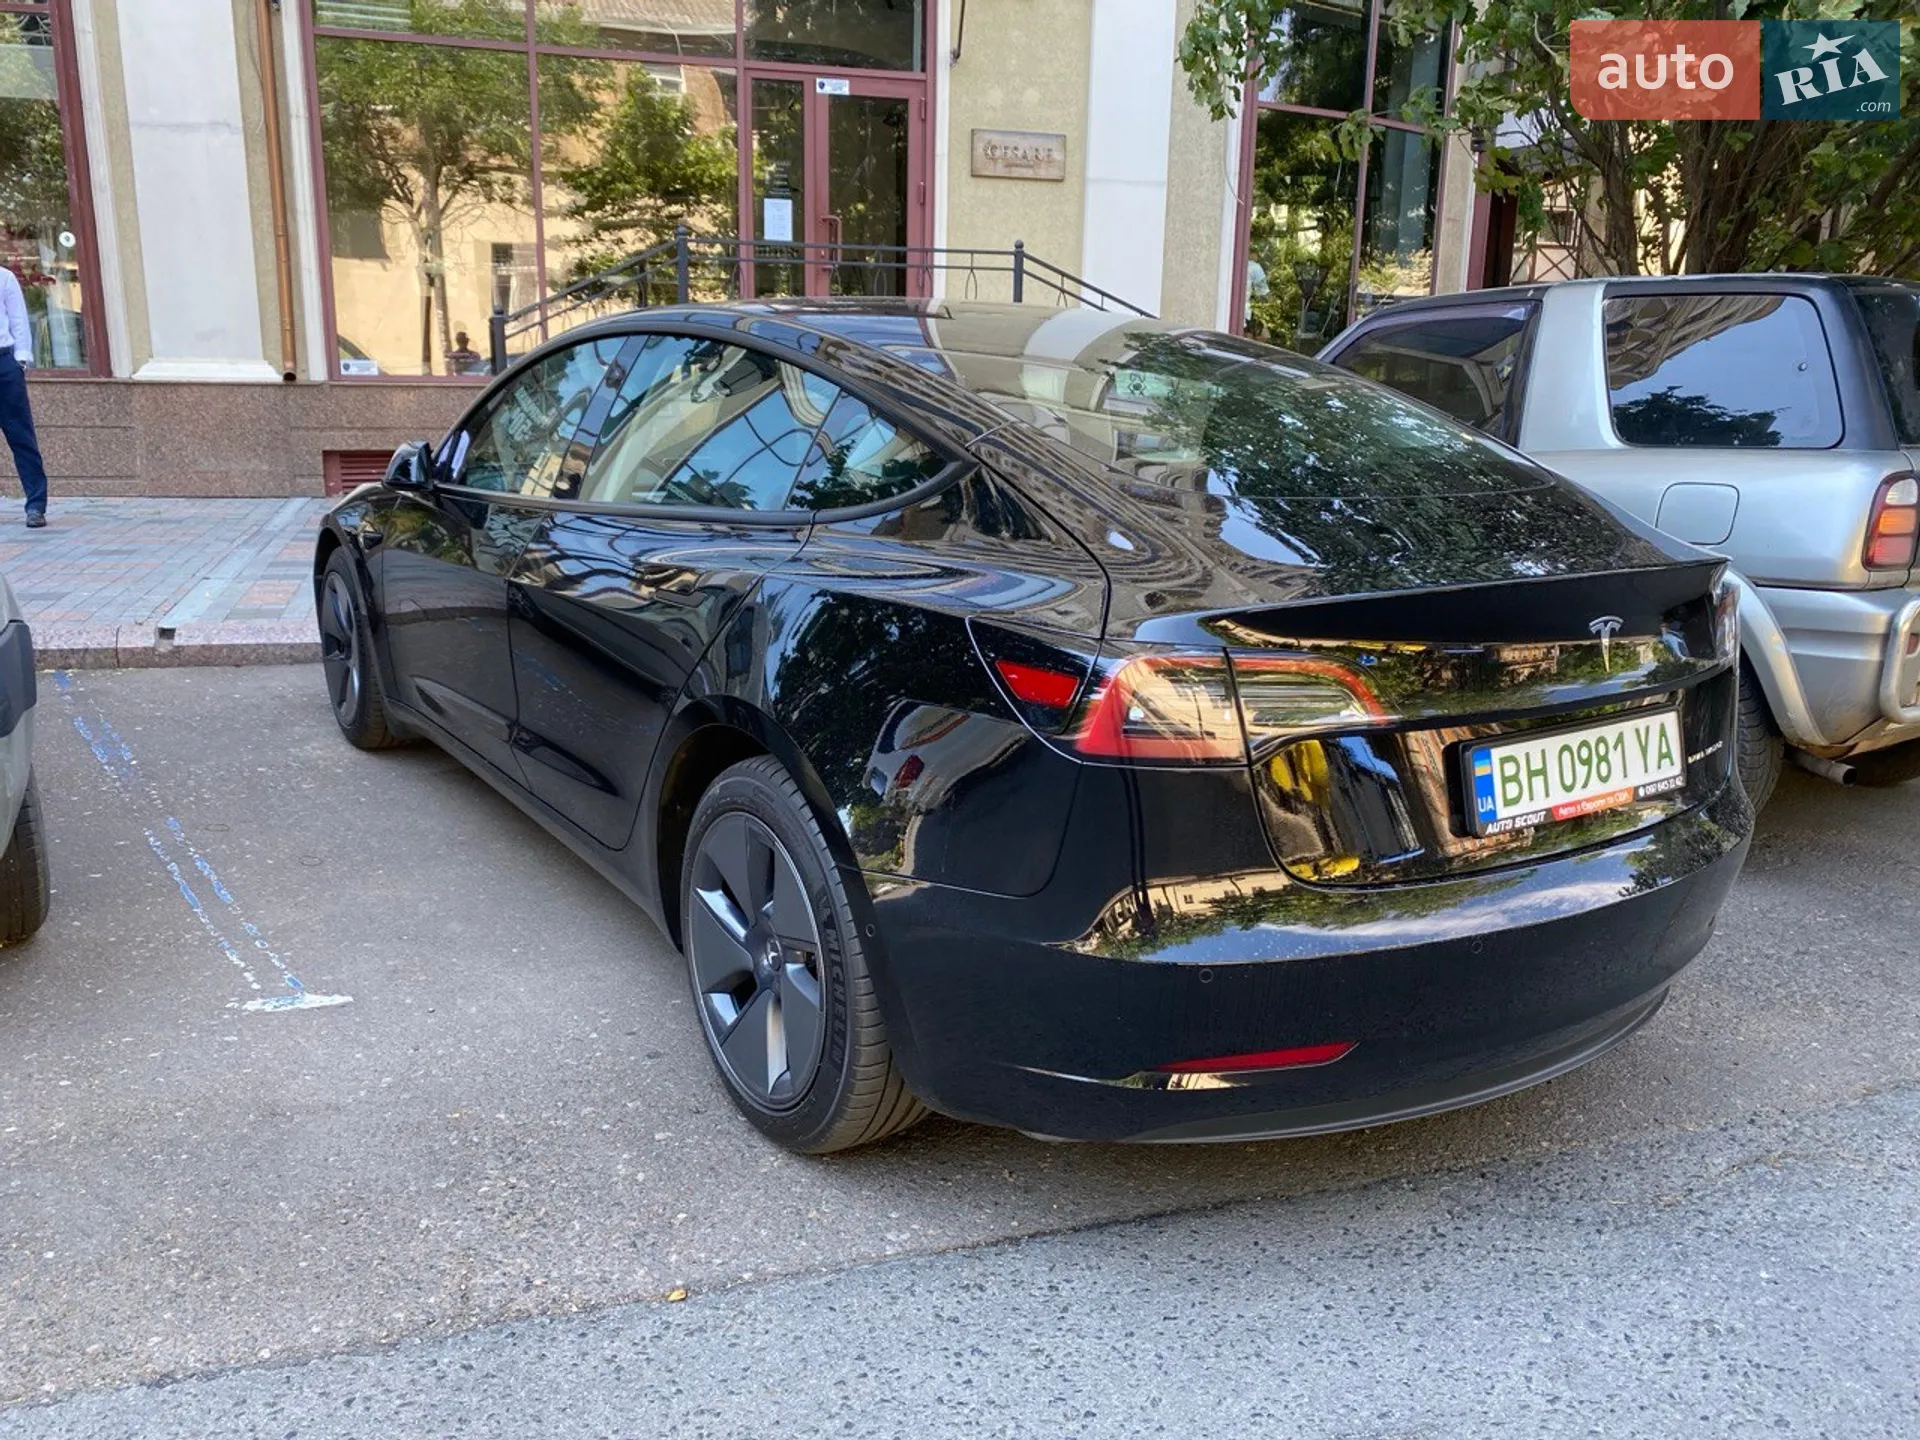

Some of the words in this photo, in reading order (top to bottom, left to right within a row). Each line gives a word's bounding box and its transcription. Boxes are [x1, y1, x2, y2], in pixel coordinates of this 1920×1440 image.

[1499, 748, 1550, 807] BH
[1557, 731, 1628, 793] 0981
[1635, 722, 1675, 774] YA
[1478, 795, 1495, 812] UA
[1485, 819, 1513, 835] AUTO
[1514, 811, 1546, 828] SCOUT
[826, 928, 847, 1065] MICHELIN
